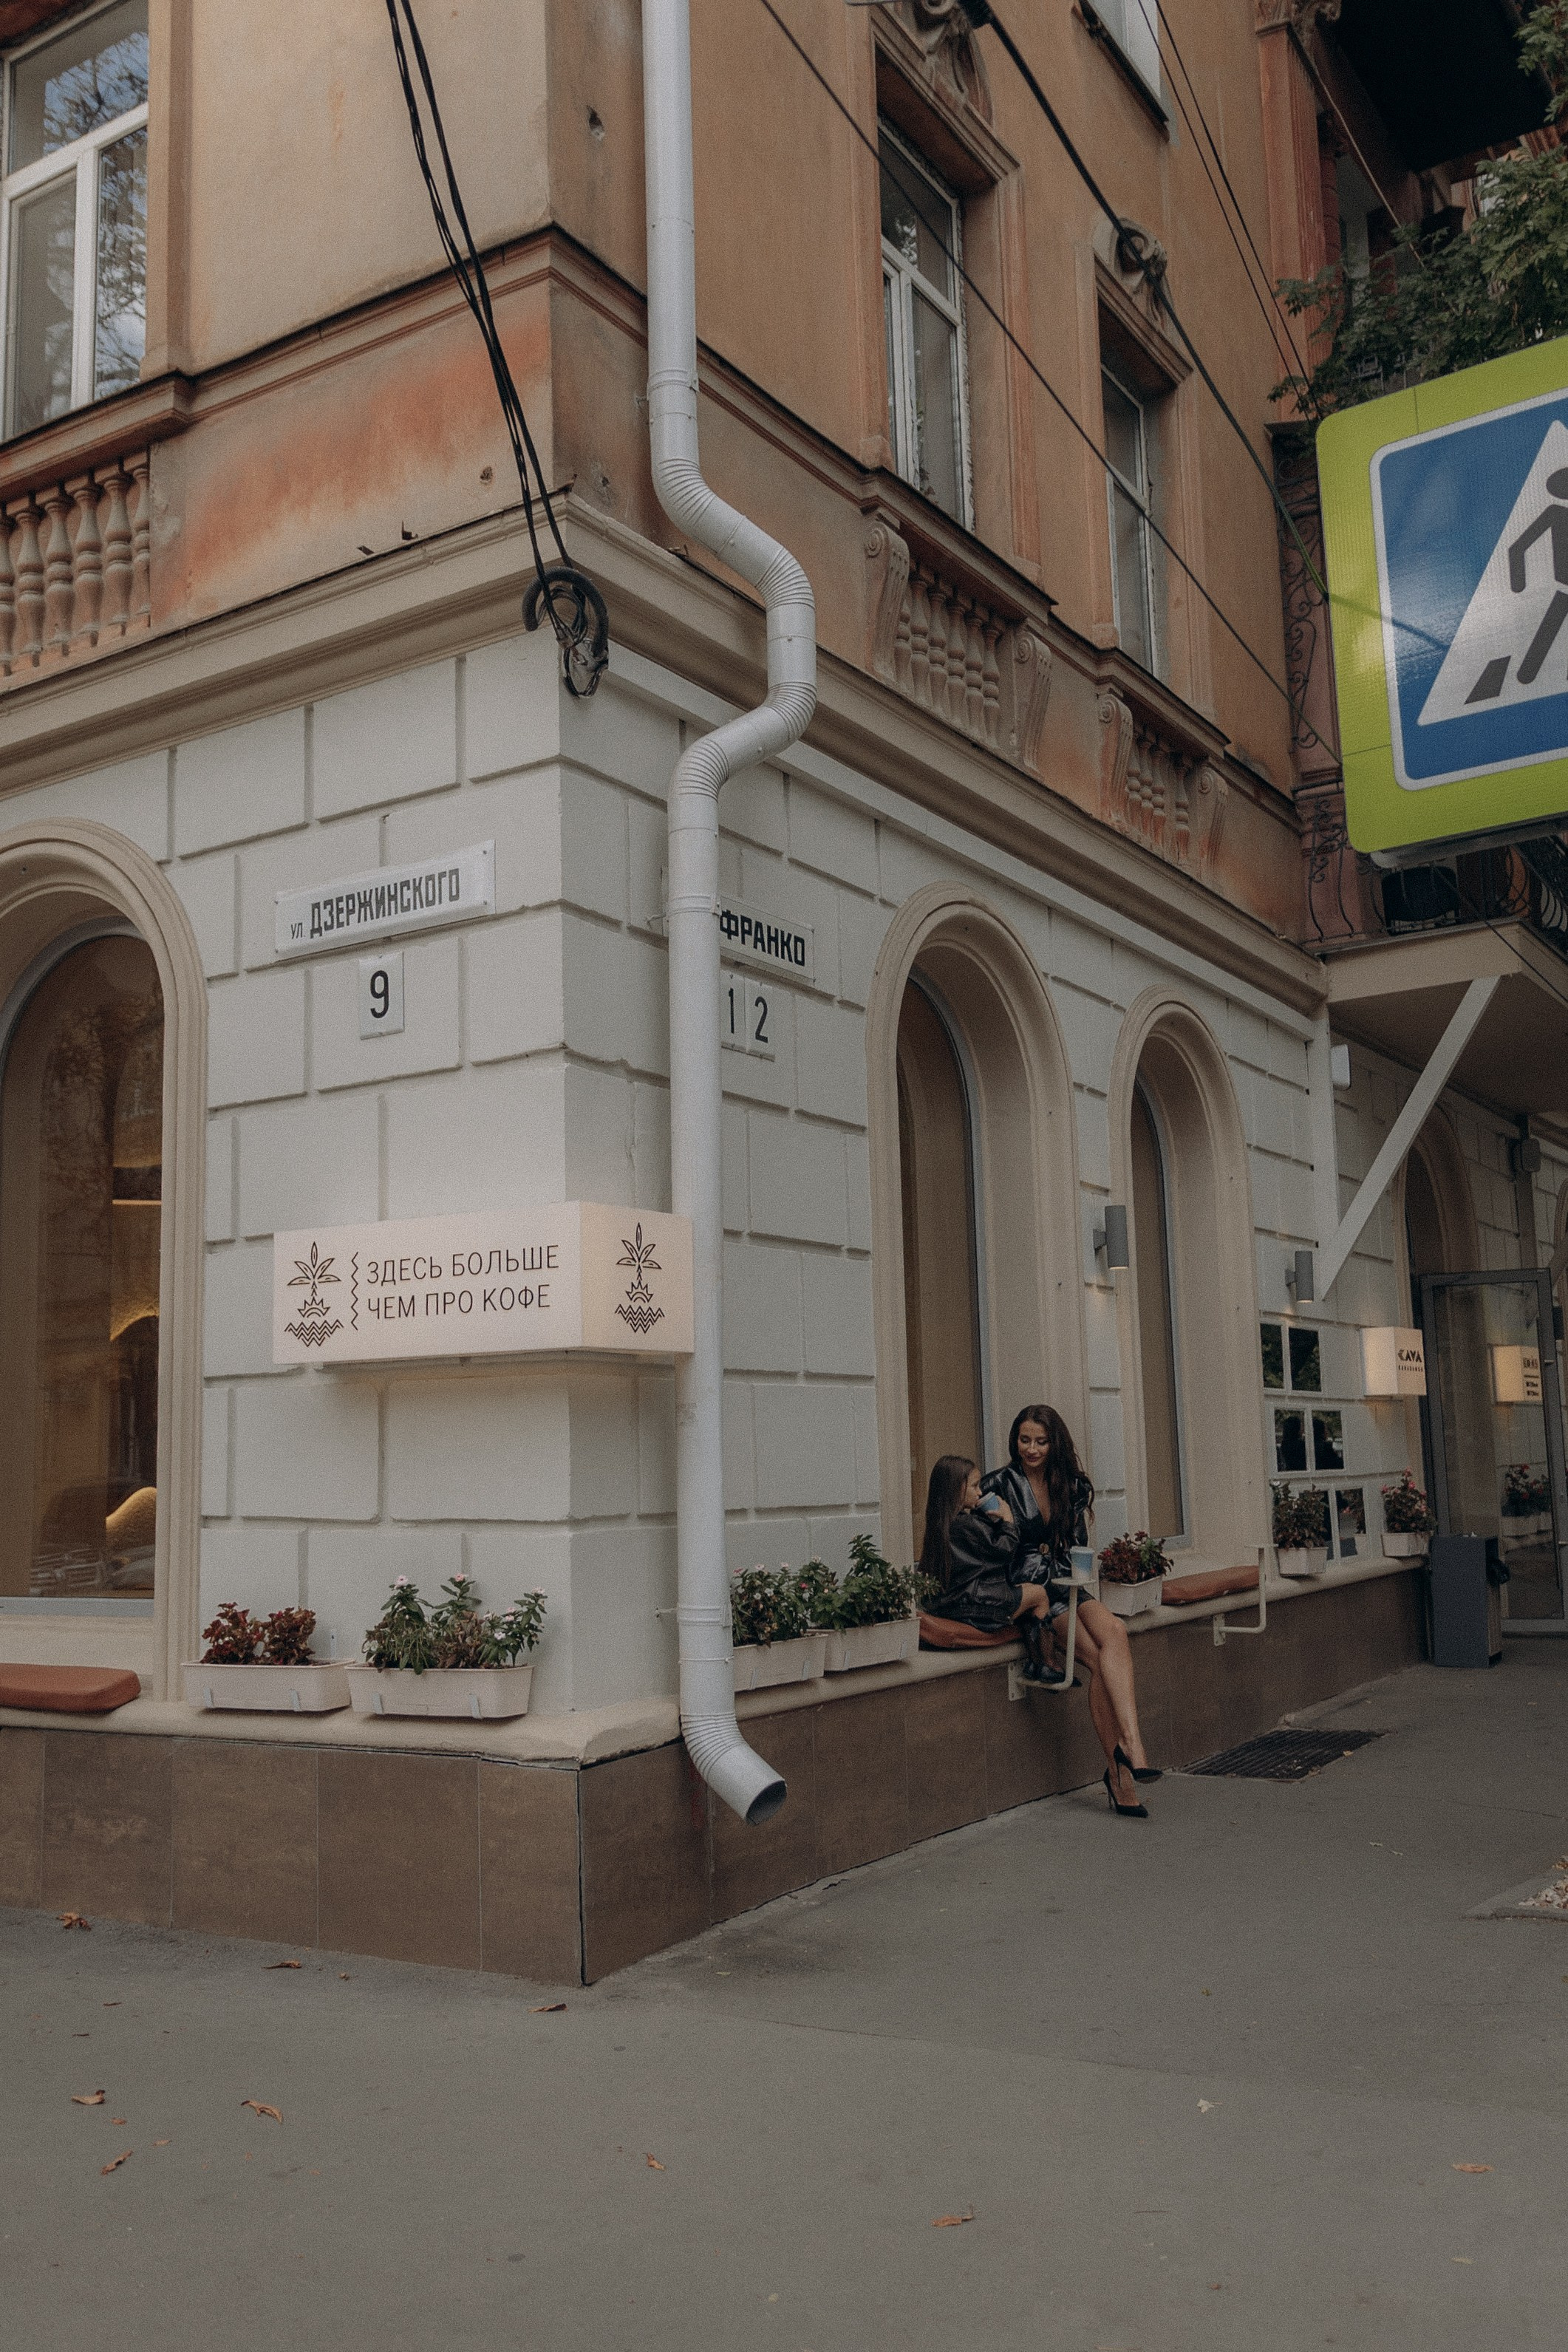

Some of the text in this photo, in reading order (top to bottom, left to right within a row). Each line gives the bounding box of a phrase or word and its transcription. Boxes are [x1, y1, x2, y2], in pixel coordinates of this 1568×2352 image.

[290, 868, 460, 939] ул. ДЗЕРЖИНСКОГО
[720, 909, 805, 967] ФРАНКО
[370, 970, 389, 1019] 9
[367, 1245, 559, 1286] ЗДЕСЬ БОЛЬШЕ
[368, 1284, 550, 1320] ЧЕМ ПРО КОФЕ
